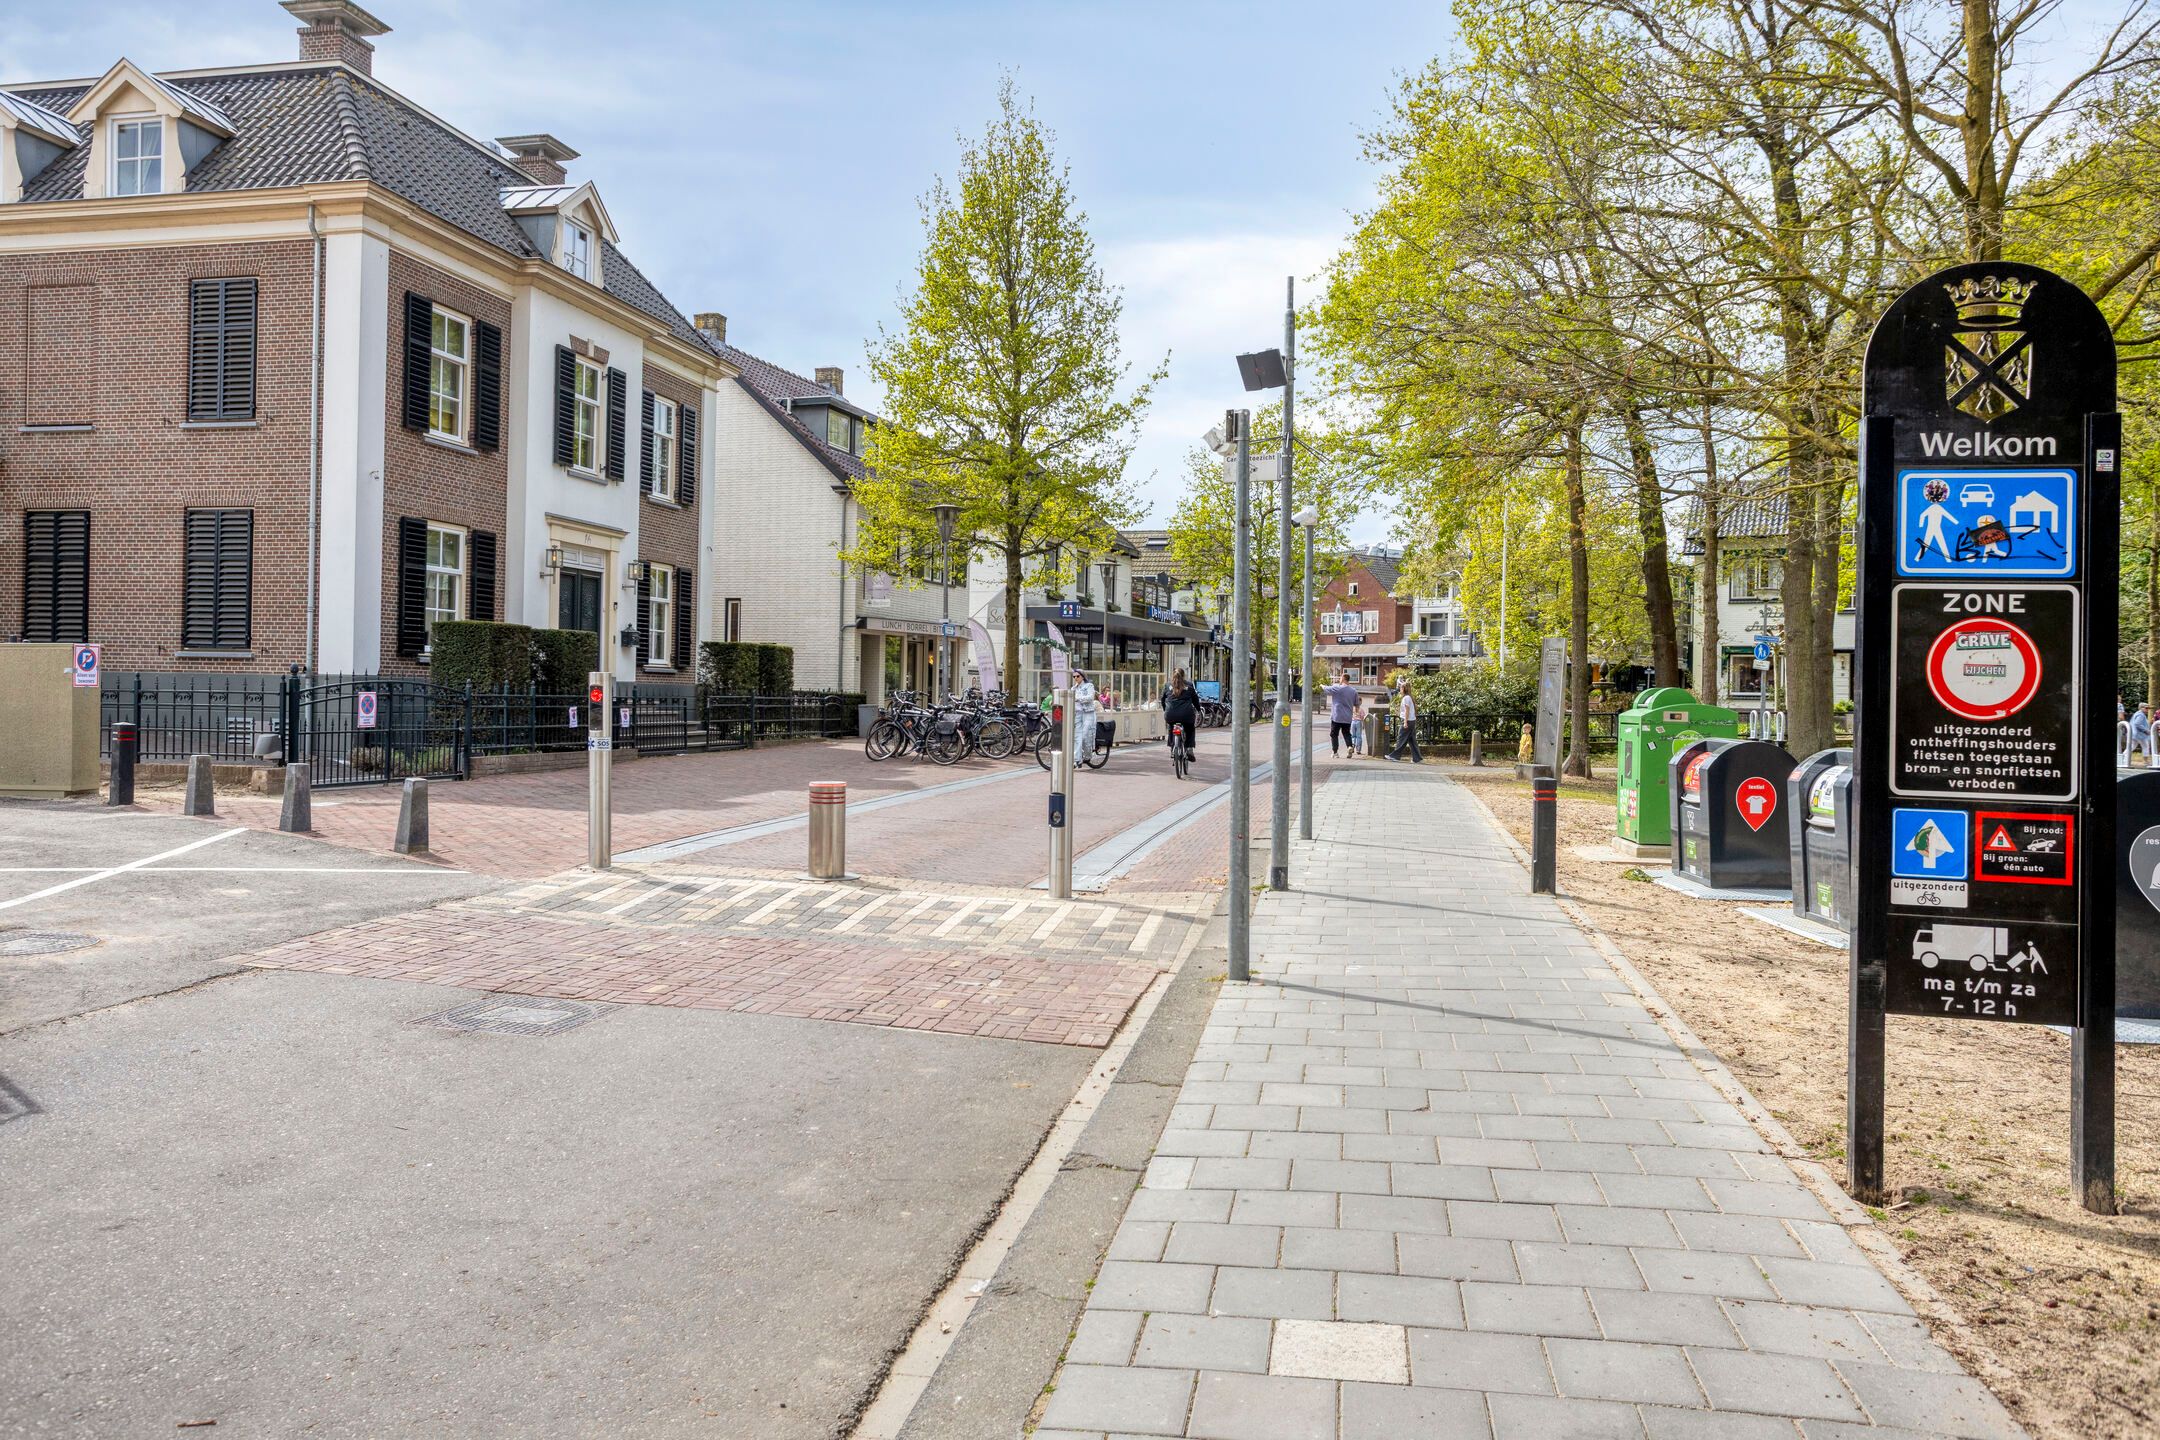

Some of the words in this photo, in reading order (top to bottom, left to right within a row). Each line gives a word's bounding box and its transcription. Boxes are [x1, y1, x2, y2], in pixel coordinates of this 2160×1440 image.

[1920, 432, 2056, 457] Welkom
[1943, 593, 2026, 613] ZONE
[882, 620, 902, 630] LUNCH
[906, 622, 929, 633] BORREL
[933, 625, 943, 633] BIT
[1958, 634, 2010, 647] GRAVE
[1934, 725, 2032, 737] uitgezonderd
[1910, 737, 2057, 751] ontheffingshouders
[1913, 750, 1964, 761] fietsen
[1969, 752, 2052, 766] toegestaan
[1905, 763, 1948, 774] brom-
[1953, 766, 1970, 775] en
[1975, 765, 2061, 778] snorfietsen
[1948, 779, 2016, 790] verboden
[2023, 825, 2036, 834] Bij
[1983, 853, 1995, 862] Bij
[1998, 855, 2028, 863] groen:
[2003, 863, 2020, 871] één
[1893, 881, 1966, 892] uitgezonderd
[1924, 979, 1956, 991] ma
[1964, 977, 2001, 994] t/m
[2011, 983, 2036, 996] za
[2005, 1000, 2017, 1016] h
